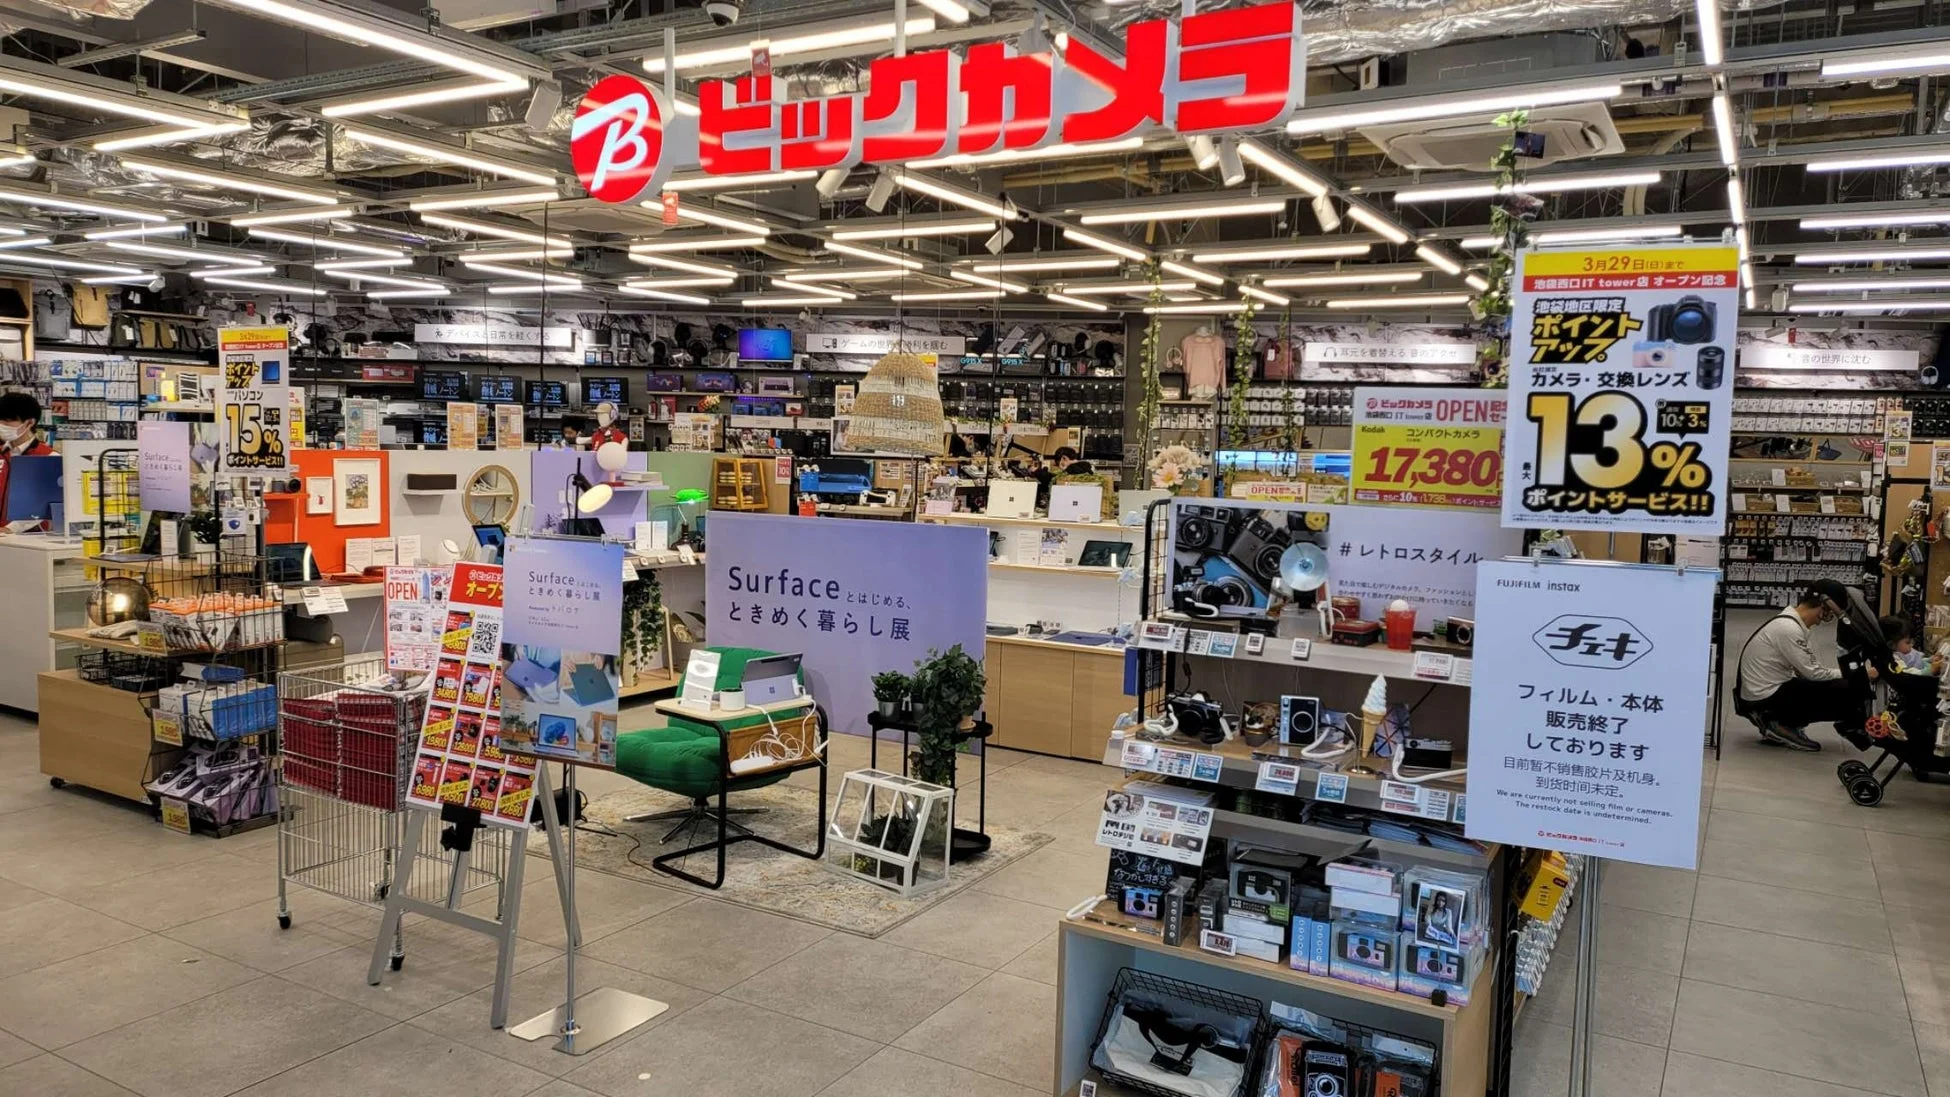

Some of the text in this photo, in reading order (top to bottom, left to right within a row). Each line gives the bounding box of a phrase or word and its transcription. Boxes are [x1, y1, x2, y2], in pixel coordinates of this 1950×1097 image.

[700, 1, 1303, 175] ビックカメラ
[1583, 255, 1685, 272] 3月29日(日)まで
[1599, 276, 1649, 288] tower店
[1653, 273, 1727, 287] オープン記念
[1536, 299, 1624, 313] 池袋地区限定
[1532, 313, 1643, 339] ポイント
[1531, 338, 1616, 362] アップ
[226, 362, 260, 376] ポイント
[1531, 371, 1691, 388] カメラ・交換レンズ
[234, 391, 264, 401] パソコン
[1381, 399, 1433, 409] ビックカメラ
[1436, 398, 1489, 422] OPEN
[1361, 425, 1386, 434] Kodak
[1405, 428, 1481, 440] コンパクトカメラ
[1526, 488, 1709, 512] ポイントサービス!!
[1340, 542, 1484, 565] # レトロスタイル
[528, 570, 575, 586] Surface
[728, 566, 912, 611] Surface とはじめる、
[1496, 578, 1581, 593] FUJIFILM instax
[387, 582, 418, 601] OPEN
[728, 601, 911, 642] ときめく暮らし展
[1545, 622, 1641, 662] チェキ
[1517, 683, 1665, 714] フィルム・本体
[1545, 710, 1630, 735] 販売終了
[1526, 732, 1651, 762] しております
[1503, 755, 1661, 788] 目前暂不销售胶片及机身。
[1535, 775, 1625, 799] 到货时间未定。
[1496, 788, 1509, 797] We
[1510, 791, 1523, 799] are
[1524, 792, 1562, 806] currently
[1563, 797, 1577, 806] not
[1579, 799, 1607, 811] selling
[1608, 802, 1624, 812] film
[1636, 807, 1674, 818] cameras.
[1515, 800, 1653, 825] The restock date is undetermined.
